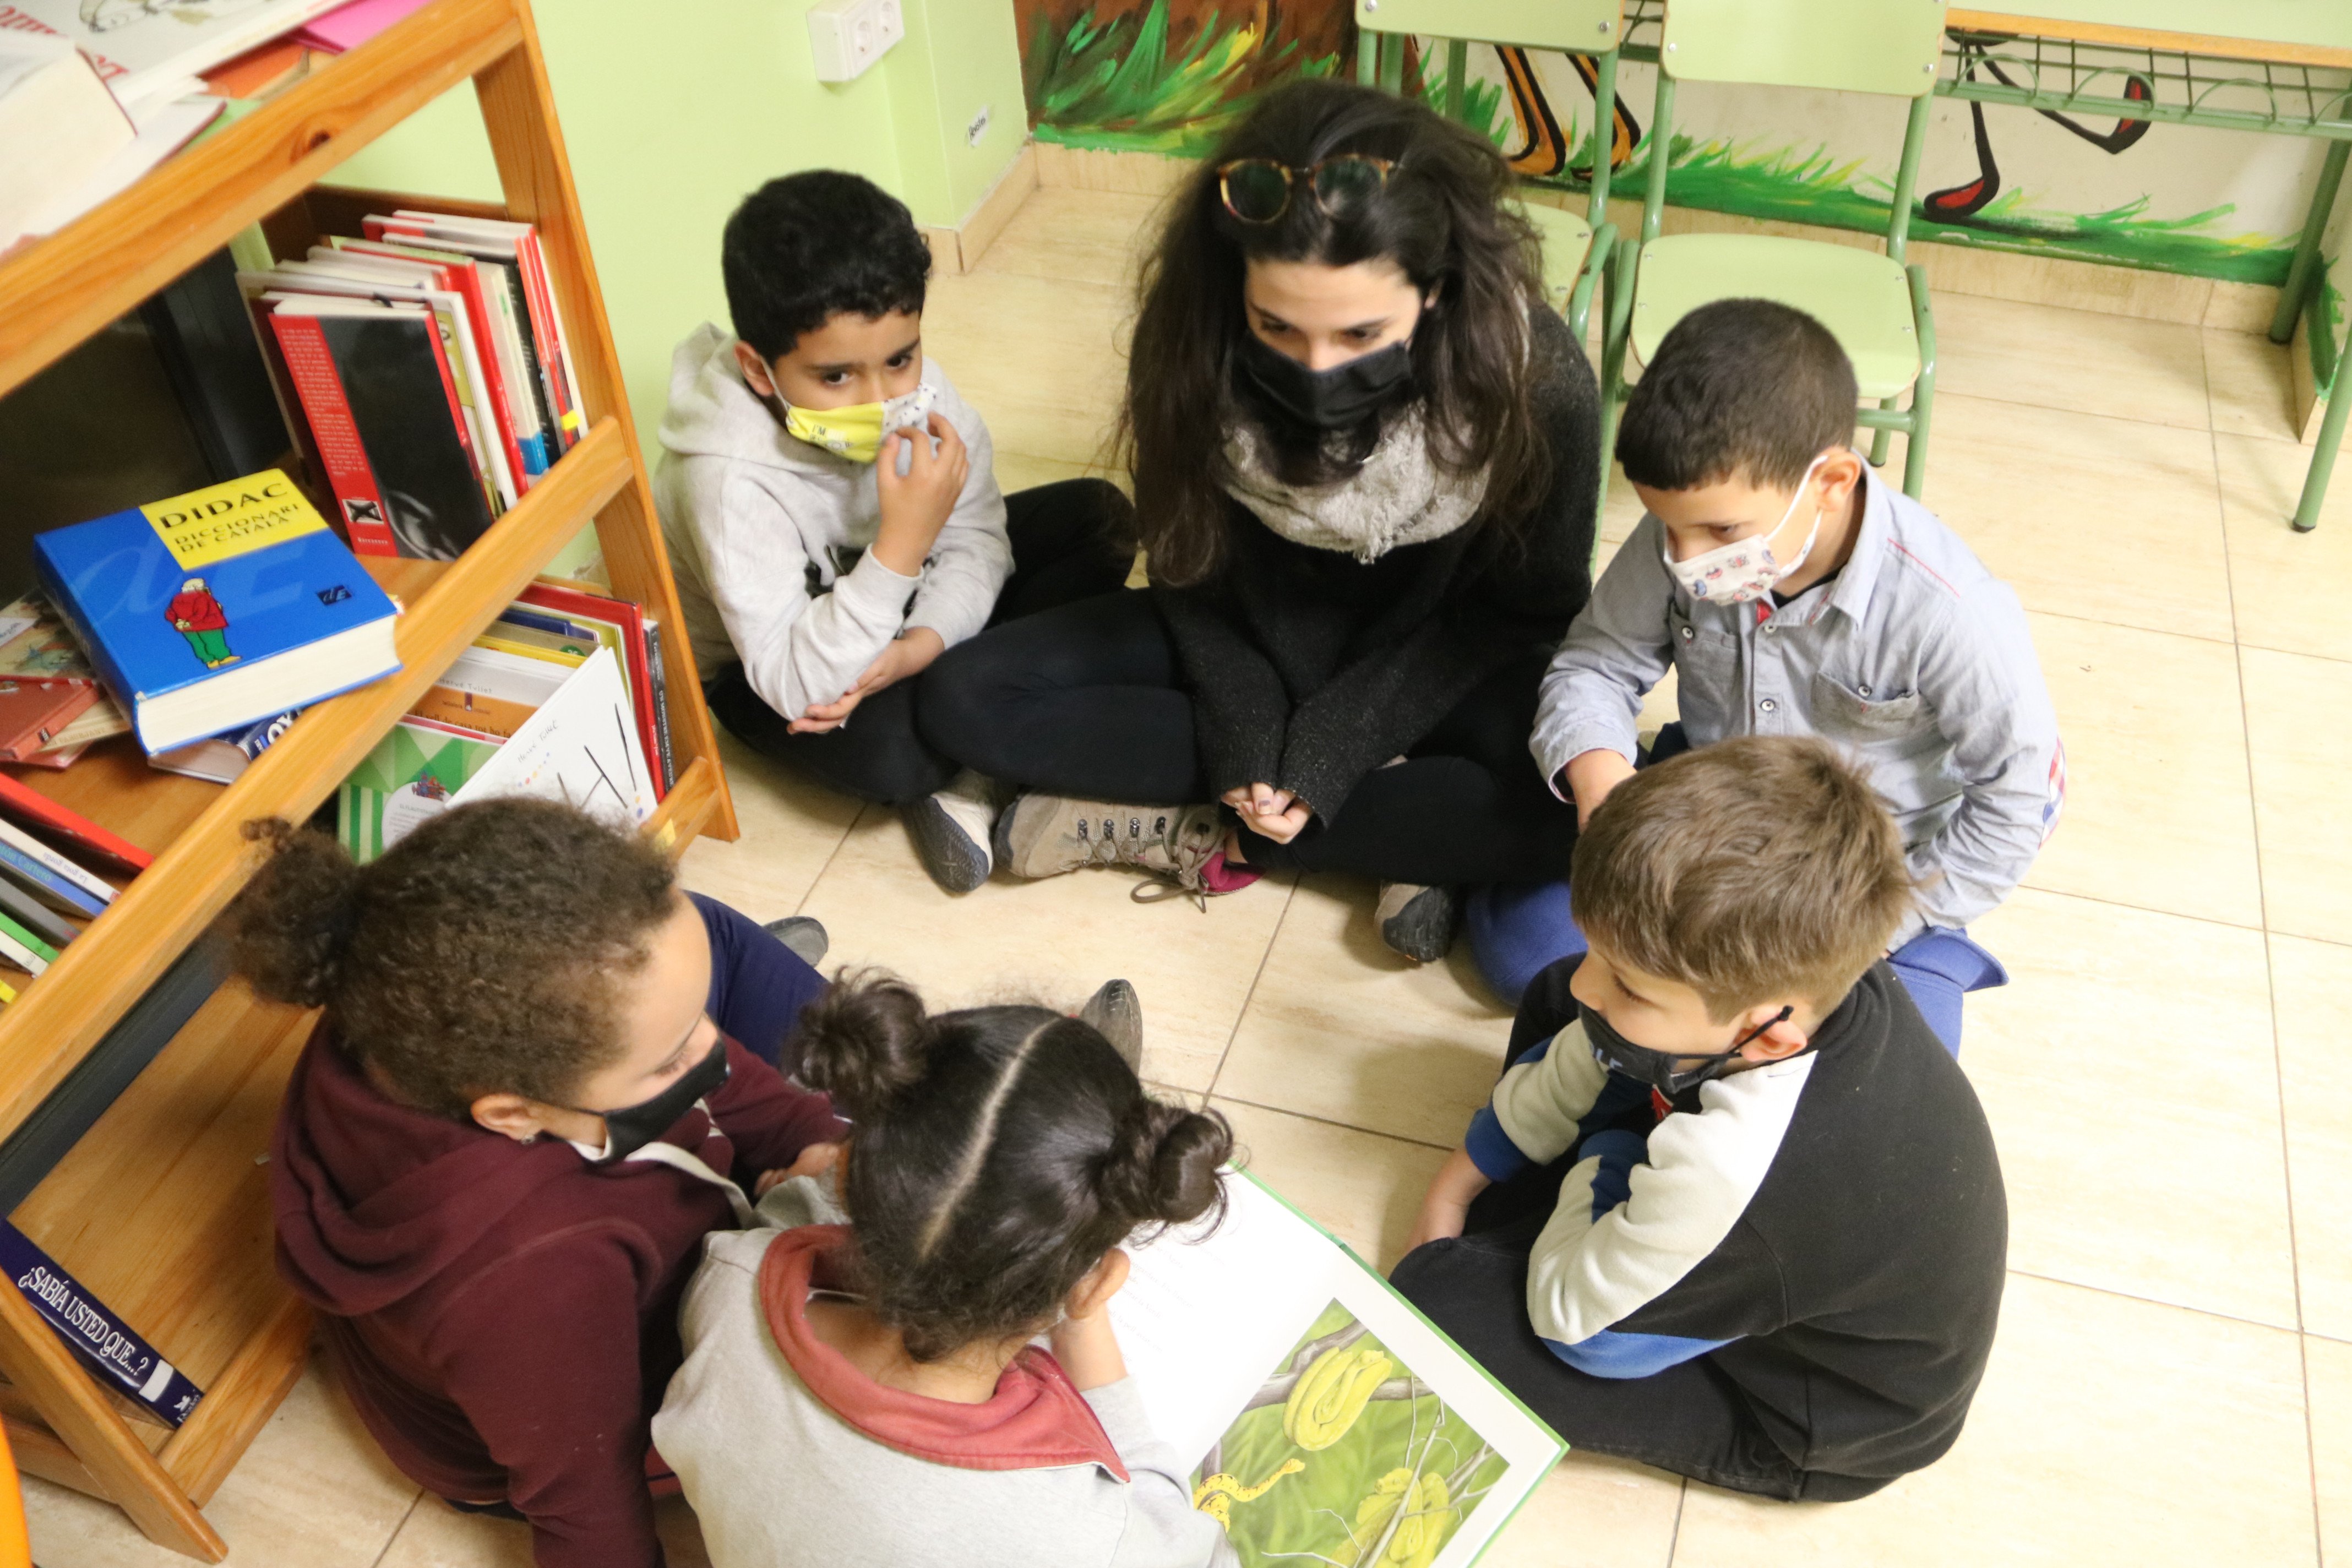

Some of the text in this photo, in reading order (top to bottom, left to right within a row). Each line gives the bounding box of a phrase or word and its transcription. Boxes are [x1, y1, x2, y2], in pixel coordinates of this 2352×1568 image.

[159, 483, 288, 529] DIDAC
[174, 504, 299, 544] DICCIONARI
[180, 540, 204, 553] DE
[43, 852, 62, 865] gorda
[64, 864, 79, 875] gota
[18, 1266, 149, 1376] ¿SABÍA USTED QUE...?
